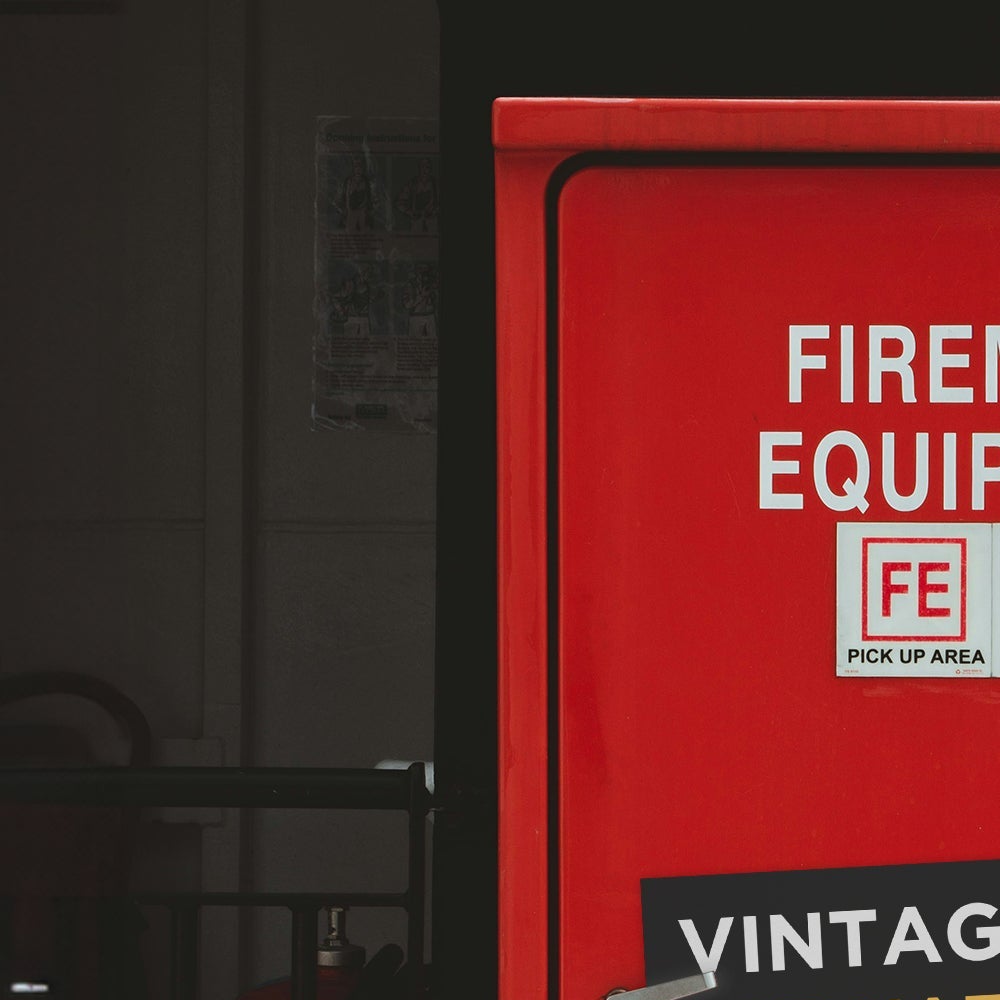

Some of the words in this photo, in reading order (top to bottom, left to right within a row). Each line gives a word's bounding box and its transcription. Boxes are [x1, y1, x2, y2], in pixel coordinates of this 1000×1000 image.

[881, 562, 951, 618] FE
[848, 648, 894, 664] PICK
[899, 648, 926, 664] UP
[930, 649, 986, 665] AREA
